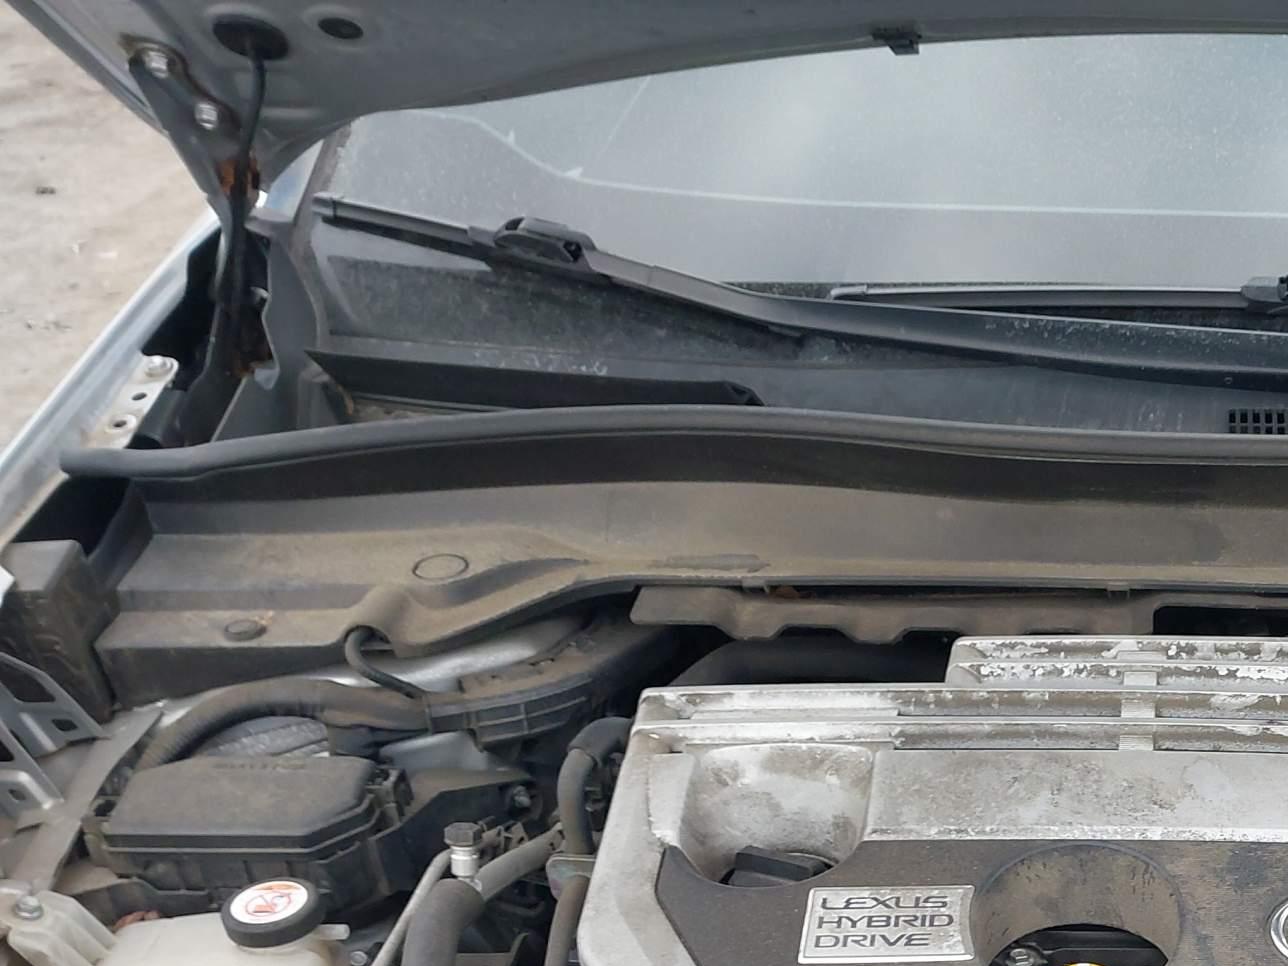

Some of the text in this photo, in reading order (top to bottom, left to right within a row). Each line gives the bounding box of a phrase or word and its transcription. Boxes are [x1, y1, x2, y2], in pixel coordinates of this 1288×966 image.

[821, 896, 949, 910] LEXUS
[817, 914, 954, 930] HYBRID
[814, 933, 933, 949] DRIVE
